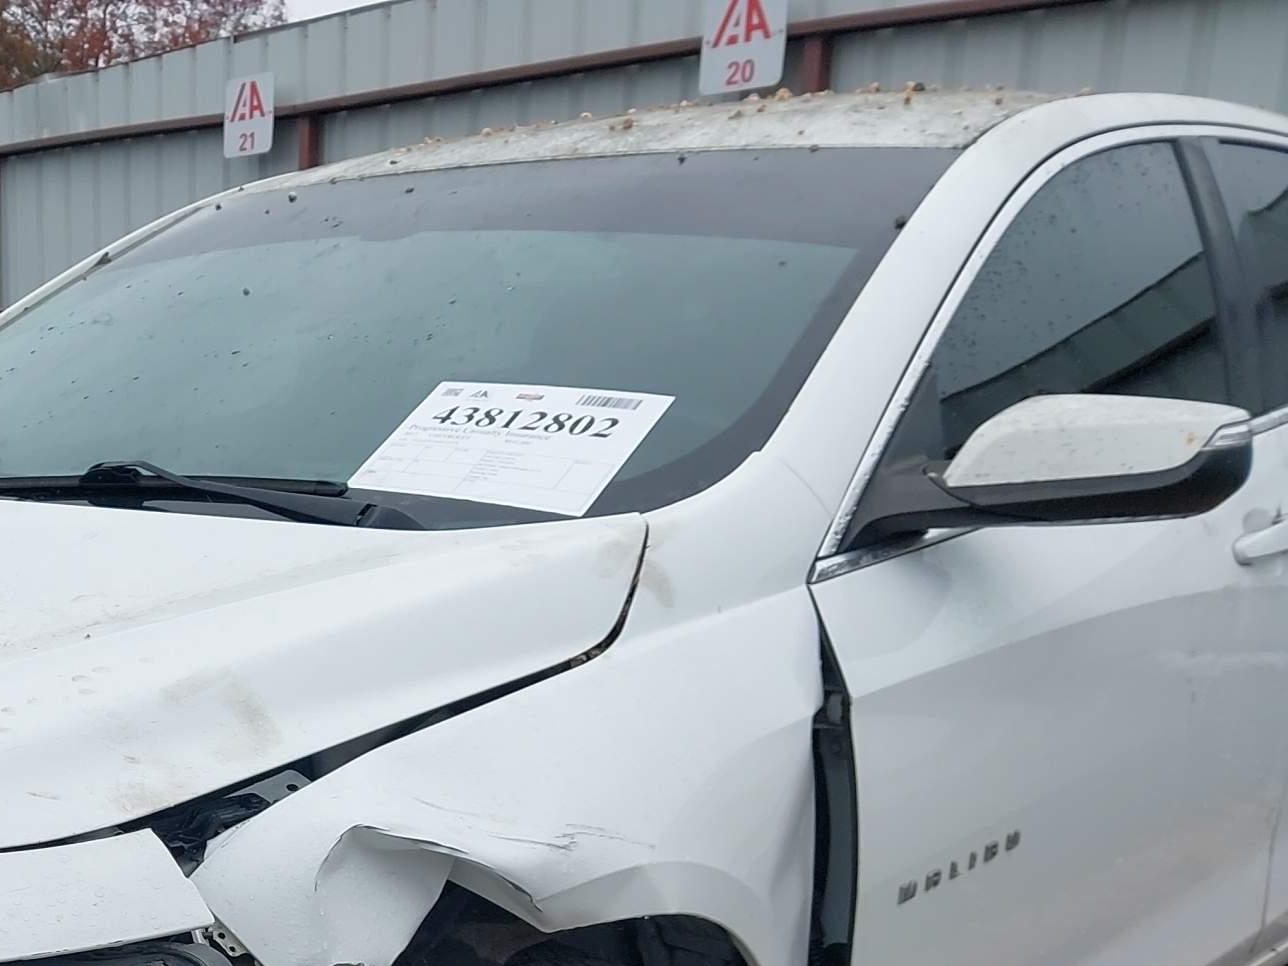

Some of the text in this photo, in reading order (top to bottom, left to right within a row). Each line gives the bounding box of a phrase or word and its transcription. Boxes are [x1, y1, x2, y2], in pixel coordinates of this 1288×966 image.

[725, 59, 755, 86] 20
[239, 131, 255, 152] 21
[431, 405, 620, 439] 43812802
